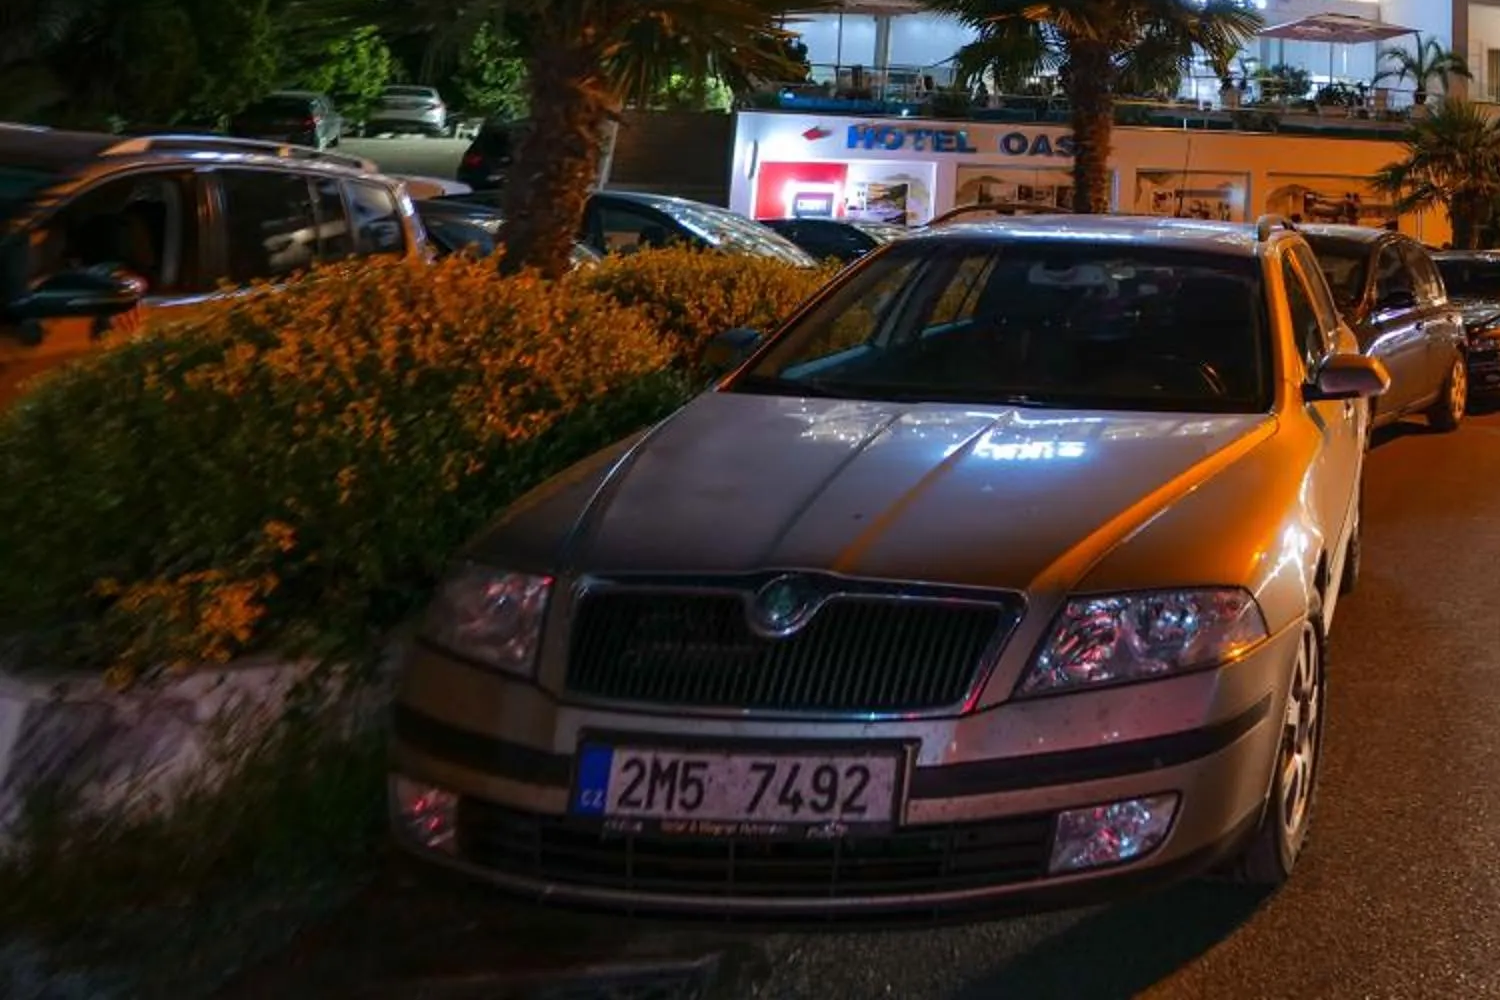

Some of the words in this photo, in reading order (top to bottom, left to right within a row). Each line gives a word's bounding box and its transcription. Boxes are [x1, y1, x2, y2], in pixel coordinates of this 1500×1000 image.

[847, 124, 977, 154] HOTEL
[1000, 131, 1080, 158] OAS
[616, 759, 708, 812] 2M5
[745, 762, 871, 815] 7492
